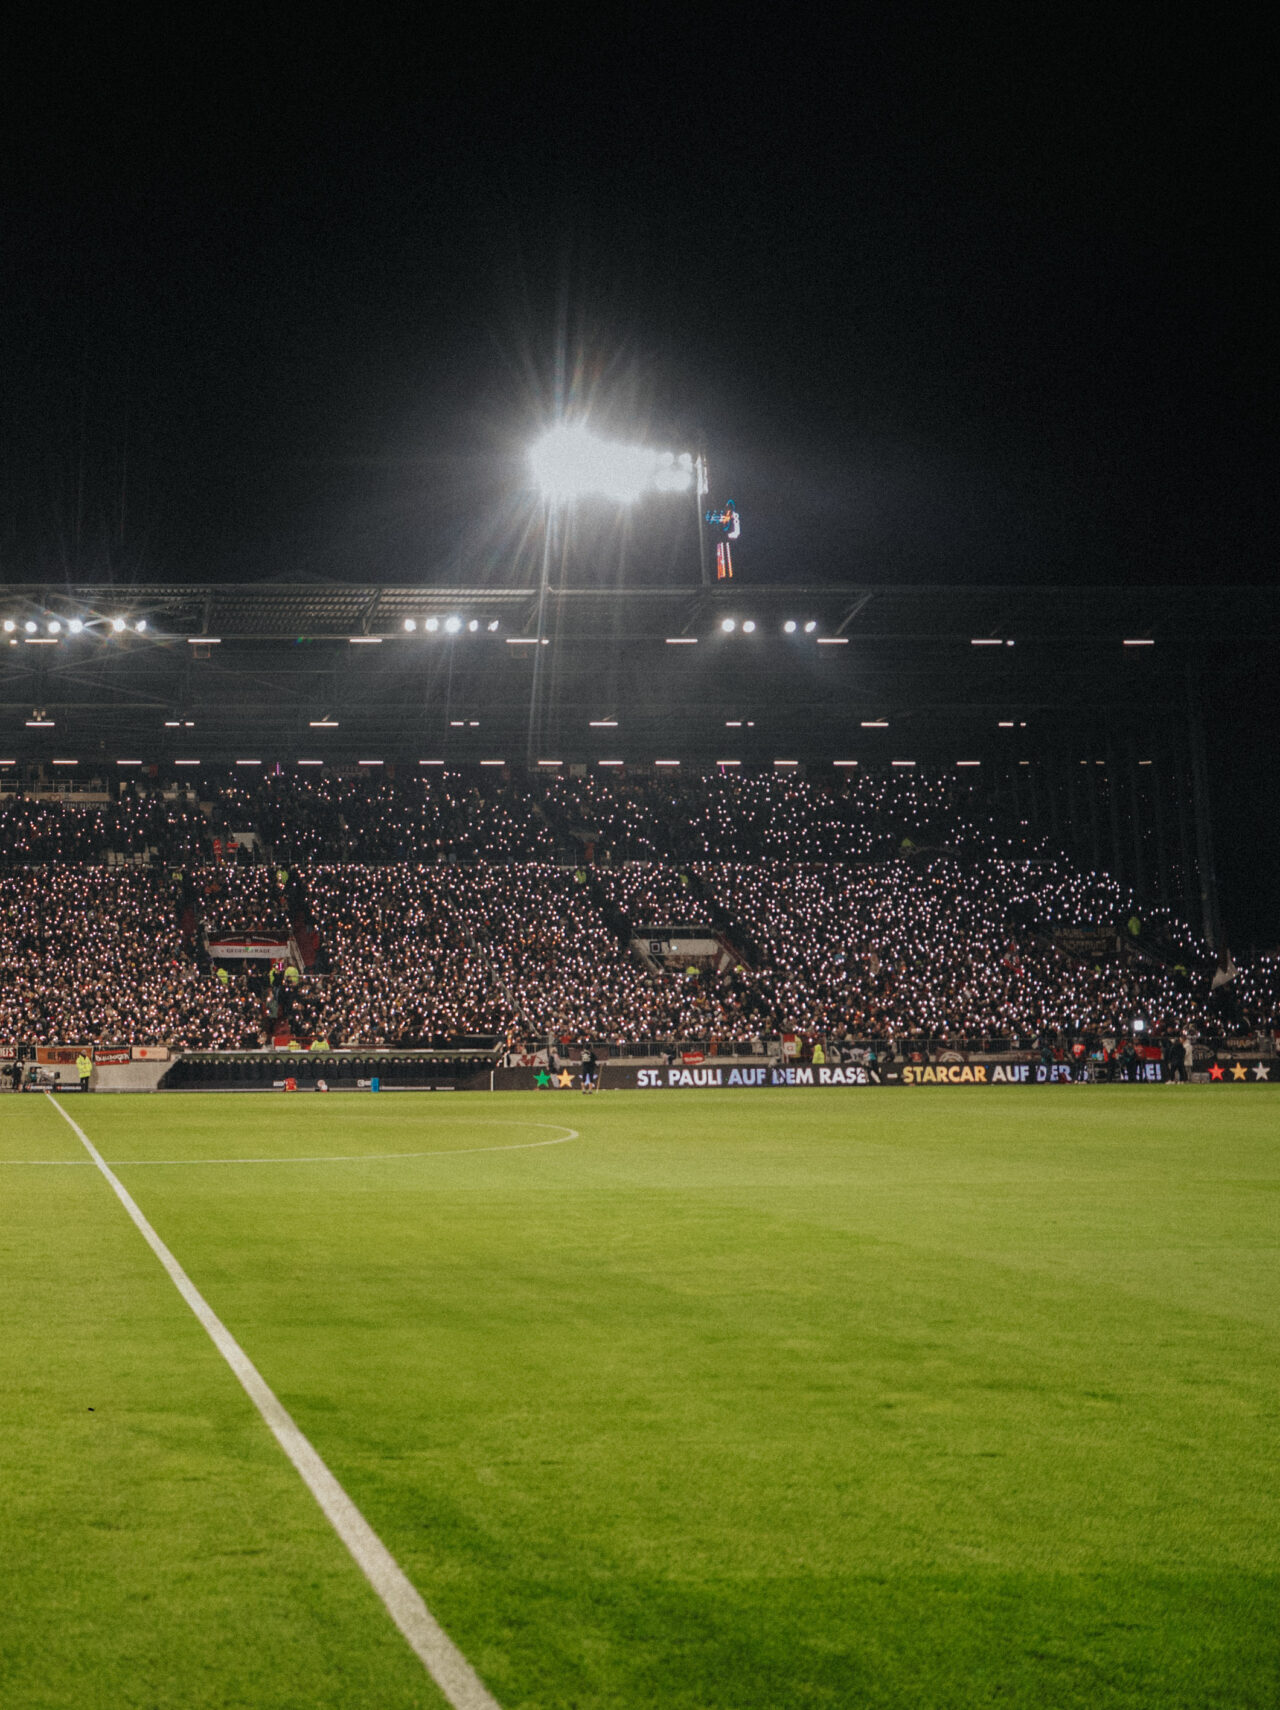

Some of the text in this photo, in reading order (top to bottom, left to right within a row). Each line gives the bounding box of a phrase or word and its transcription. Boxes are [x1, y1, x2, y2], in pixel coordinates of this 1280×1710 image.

[637, 1069, 663, 1086] ST.
[669, 1068, 722, 1086] PAULI
[728, 1068, 766, 1085] AUF
[903, 1066, 987, 1083] STARCAR
[992, 1065, 1030, 1082] AUF
[1037, 1064, 1072, 1082] DER
